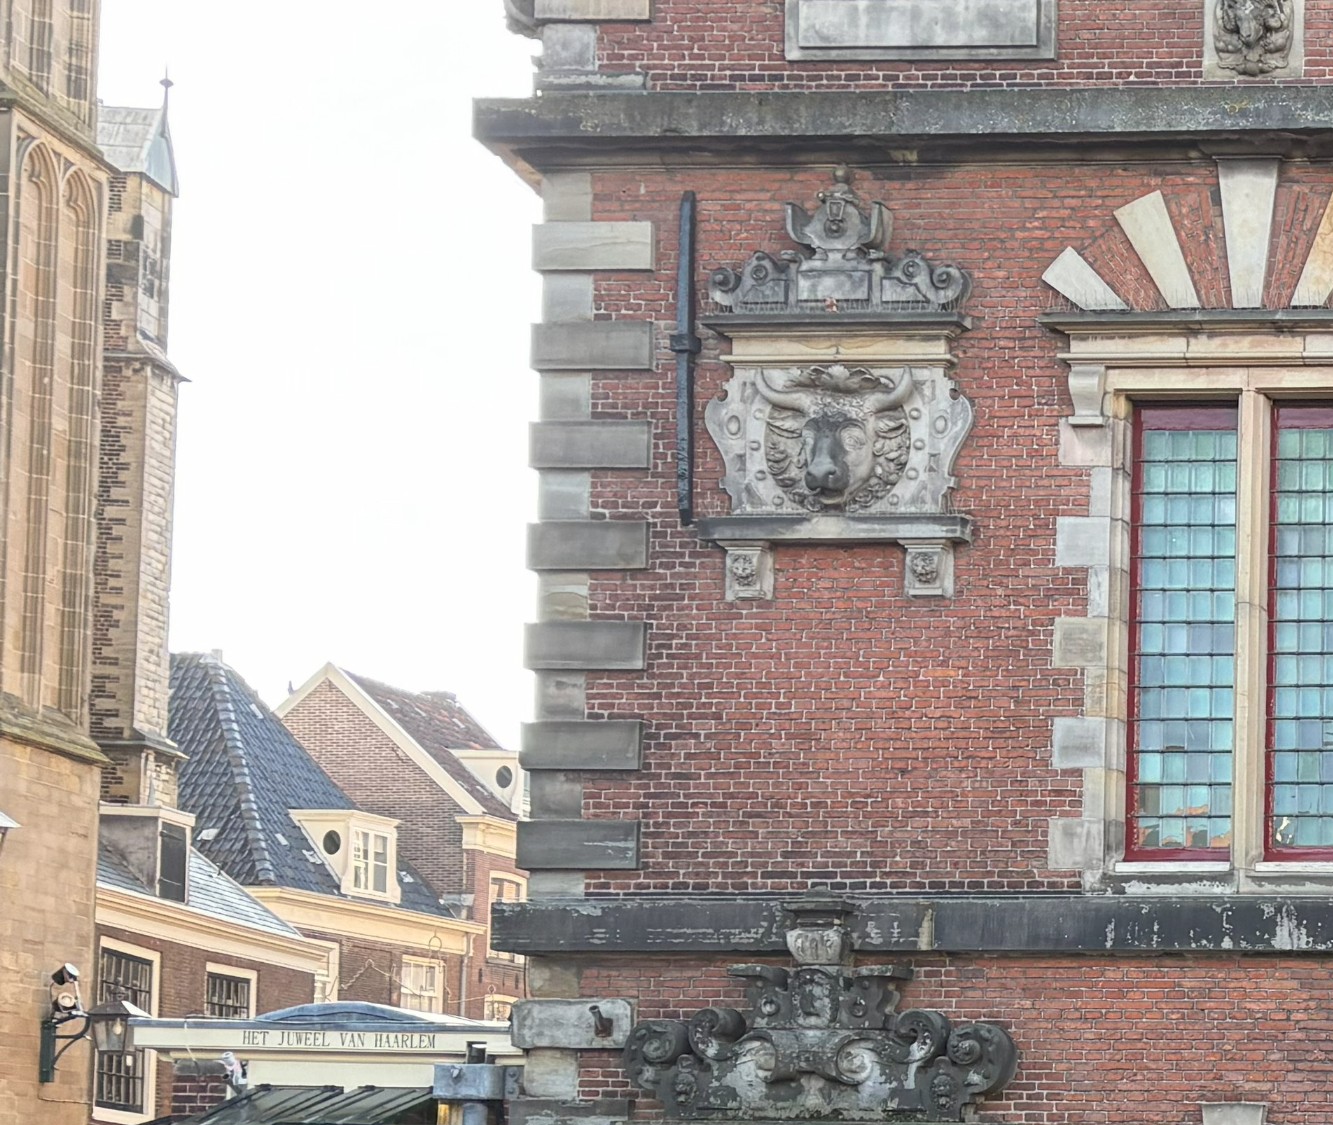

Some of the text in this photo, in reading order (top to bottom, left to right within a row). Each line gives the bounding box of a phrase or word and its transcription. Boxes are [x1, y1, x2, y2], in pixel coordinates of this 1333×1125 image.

[242, 1030, 437, 1049] HET JUWEEL VAN HAARLEM
